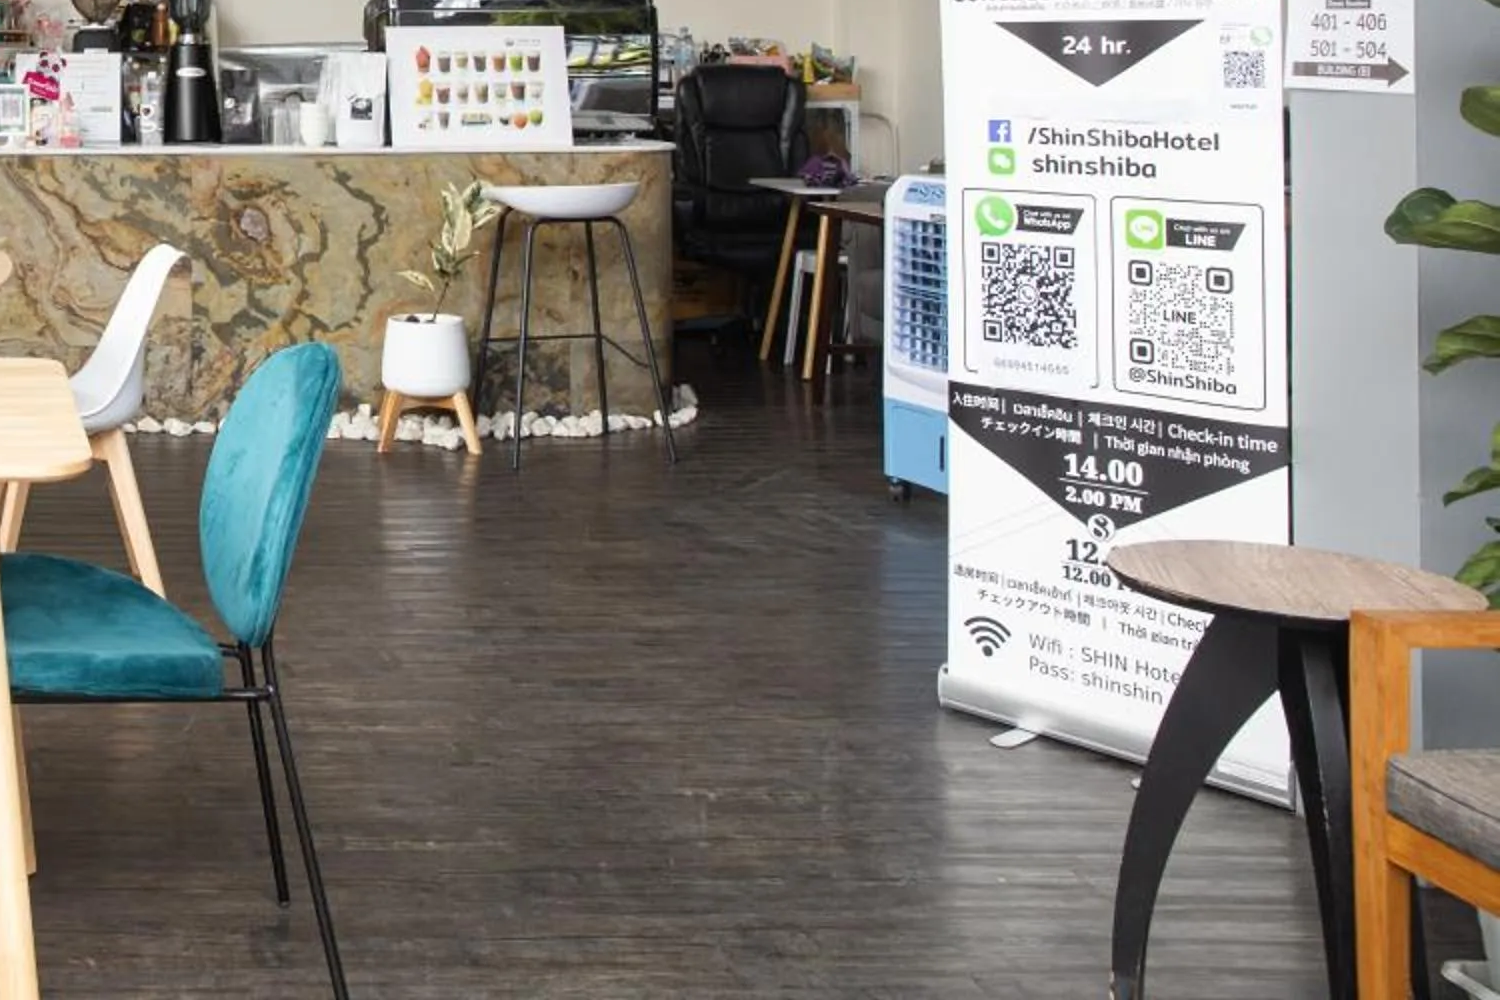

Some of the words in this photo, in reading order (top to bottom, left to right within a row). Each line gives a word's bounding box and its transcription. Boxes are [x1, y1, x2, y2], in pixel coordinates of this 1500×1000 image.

[1311, 13, 1337, 31] 401
[1356, 13, 1387, 31] 406
[1062, 36, 1092, 55] 24
[1100, 36, 1131, 55] hr.
[1310, 40, 1337, 57] 501
[1356, 41, 1387, 59] 504
[1027, 127, 1220, 152] /ShinShibaHotel
[1032, 153, 1157, 178] shinshiba
[1023, 216, 1072, 231] WhatsApp
[1185, 234, 1217, 247] LINE
[1163, 310, 1197, 325] LINE
[1129, 367, 1237, 395] @ShinShiba
[1130, 417, 1156, 435] 시간
[1167, 423, 1234, 447] Check-in
[1237, 434, 1279, 453] time
[1137, 443, 1165, 457] gian
[1063, 453, 1144, 488] 14.00
[1065, 486, 1106, 508] 2.00
[1110, 494, 1143, 514] PM
[1066, 538, 1107, 567] 12.
[1062, 565, 1112, 589] 12.00
[1029, 632, 1063, 656] Wifi
[1081, 646, 1128, 672] SHIN
[1135, 659, 1182, 685] Hote
[1029, 655, 1076, 682] Pass:
[1081, 670, 1164, 705] shinshin
